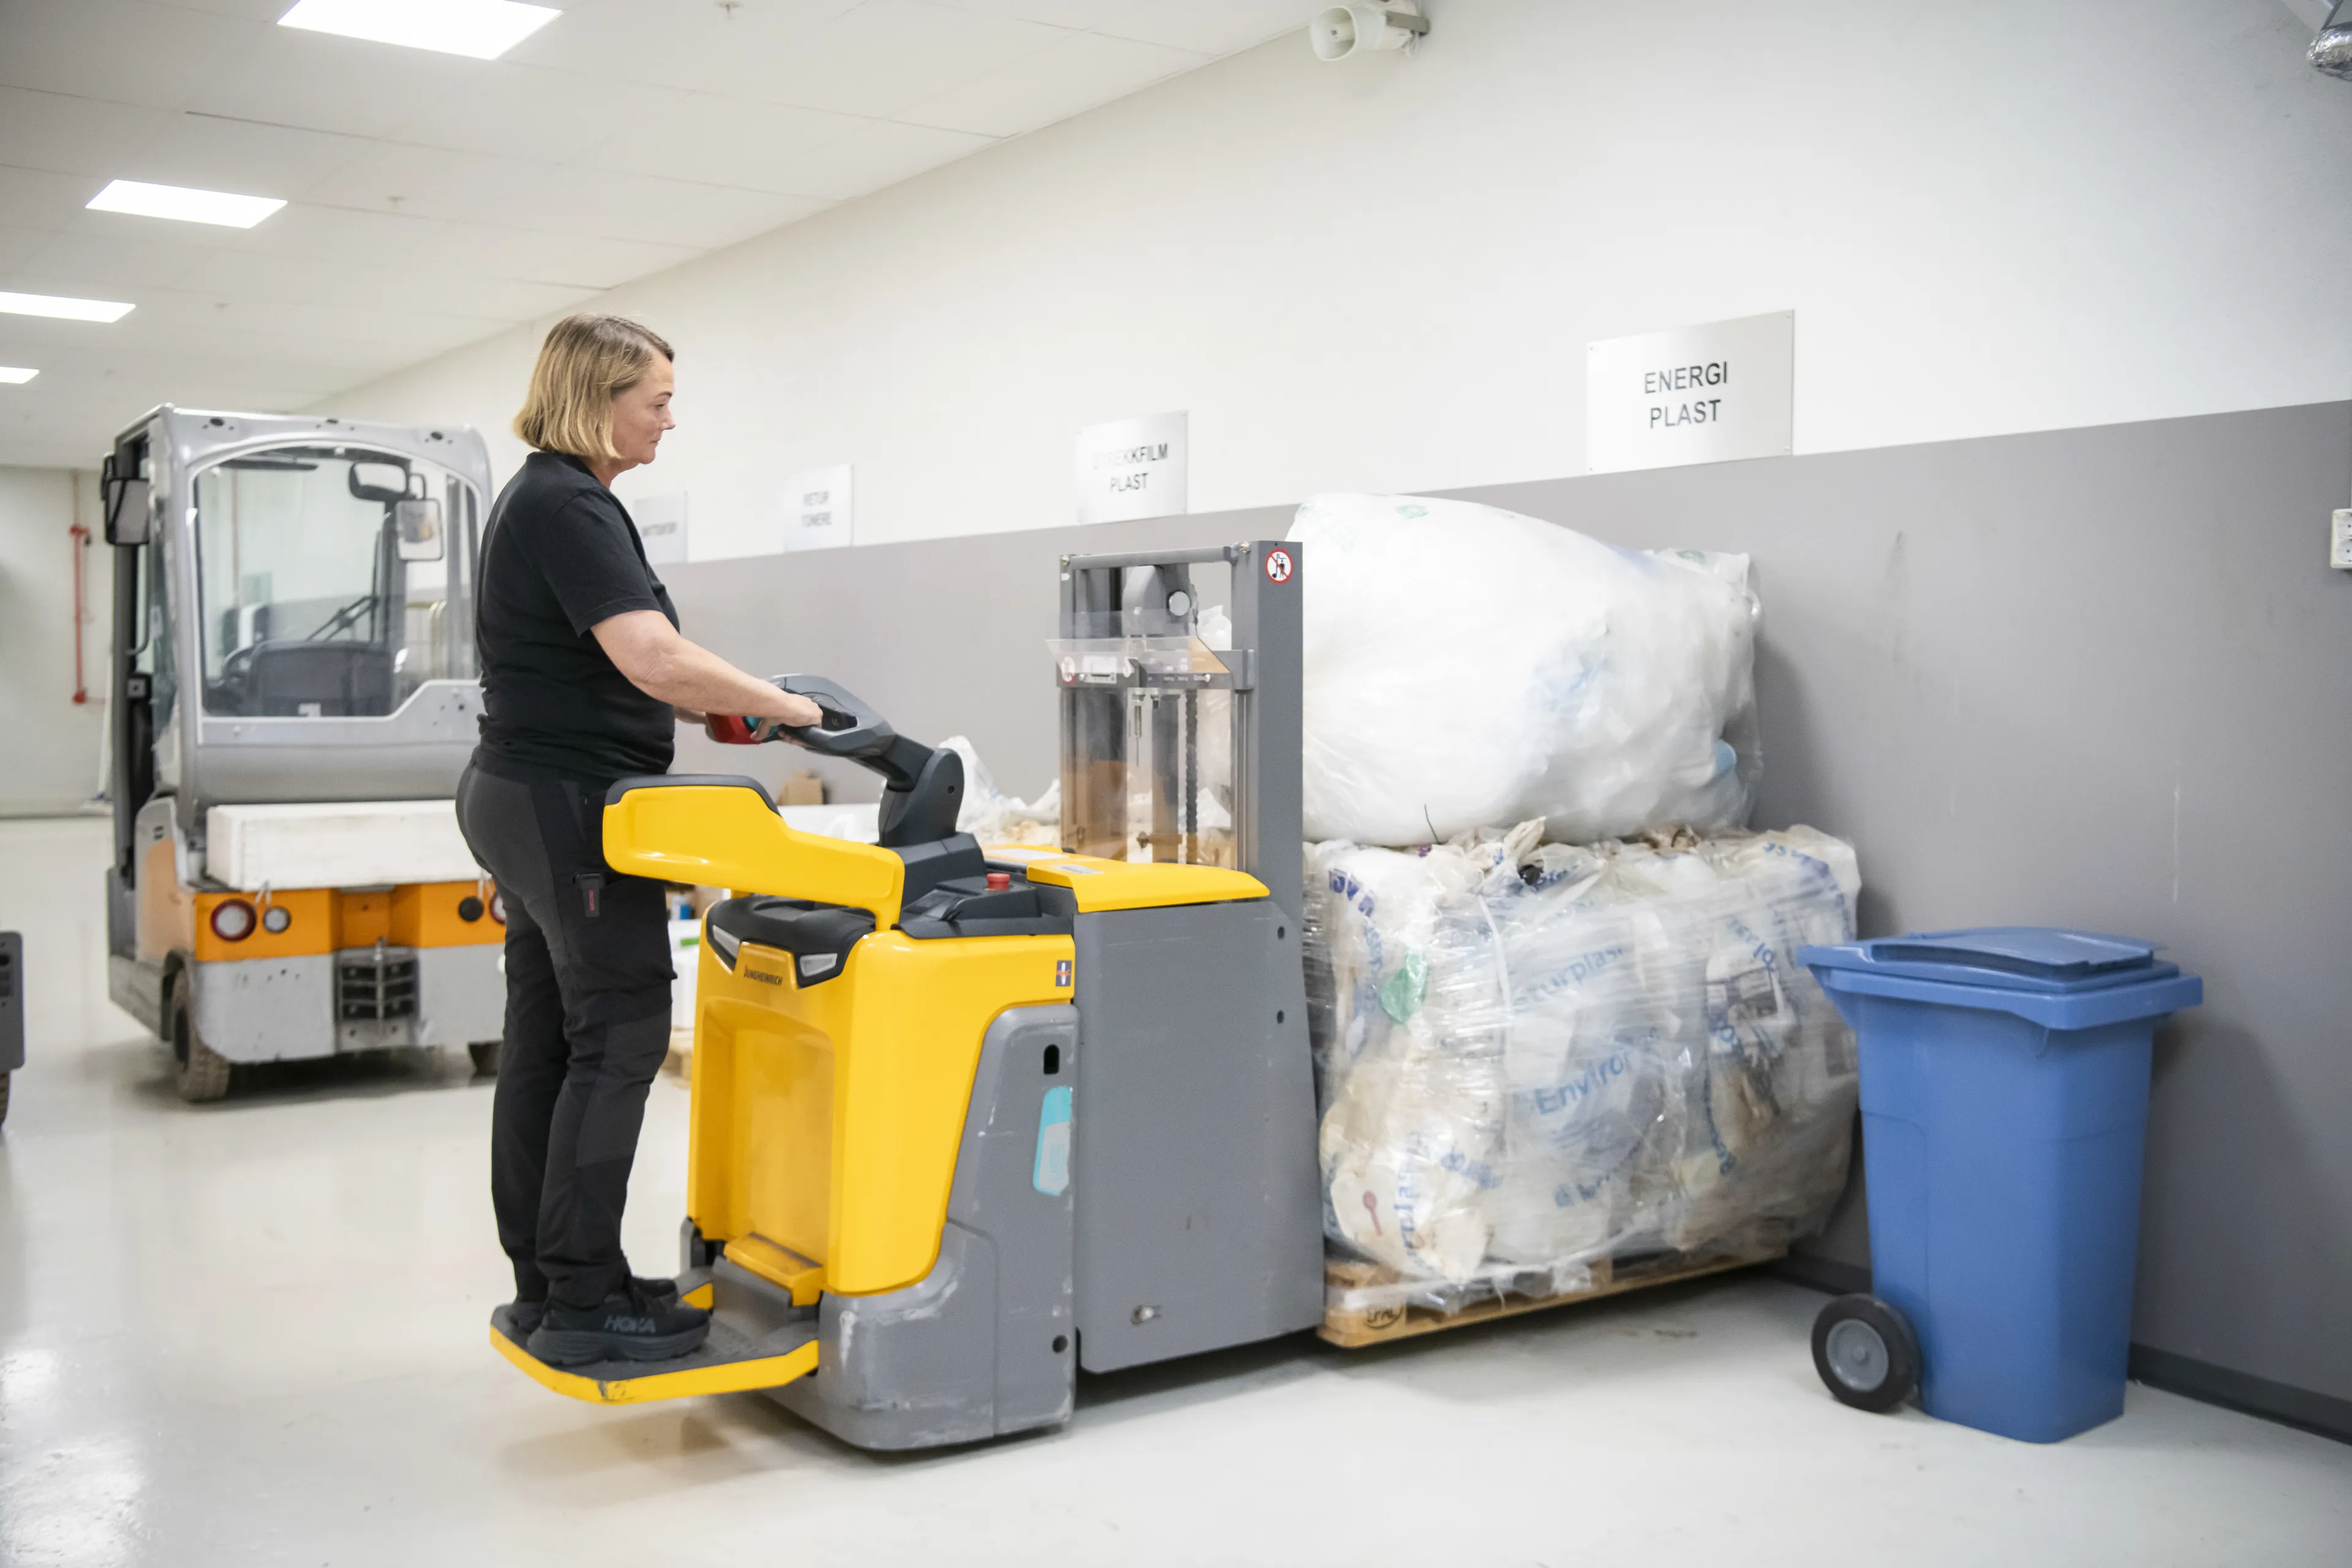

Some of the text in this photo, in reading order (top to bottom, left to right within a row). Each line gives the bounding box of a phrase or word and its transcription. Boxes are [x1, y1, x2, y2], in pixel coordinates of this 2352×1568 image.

[1645, 361, 1728, 394] ENERGI
[1649, 399, 1722, 429] PLAST
[1109, 472, 1149, 493] PLAST
[603, 1314, 657, 1334] HOKA
